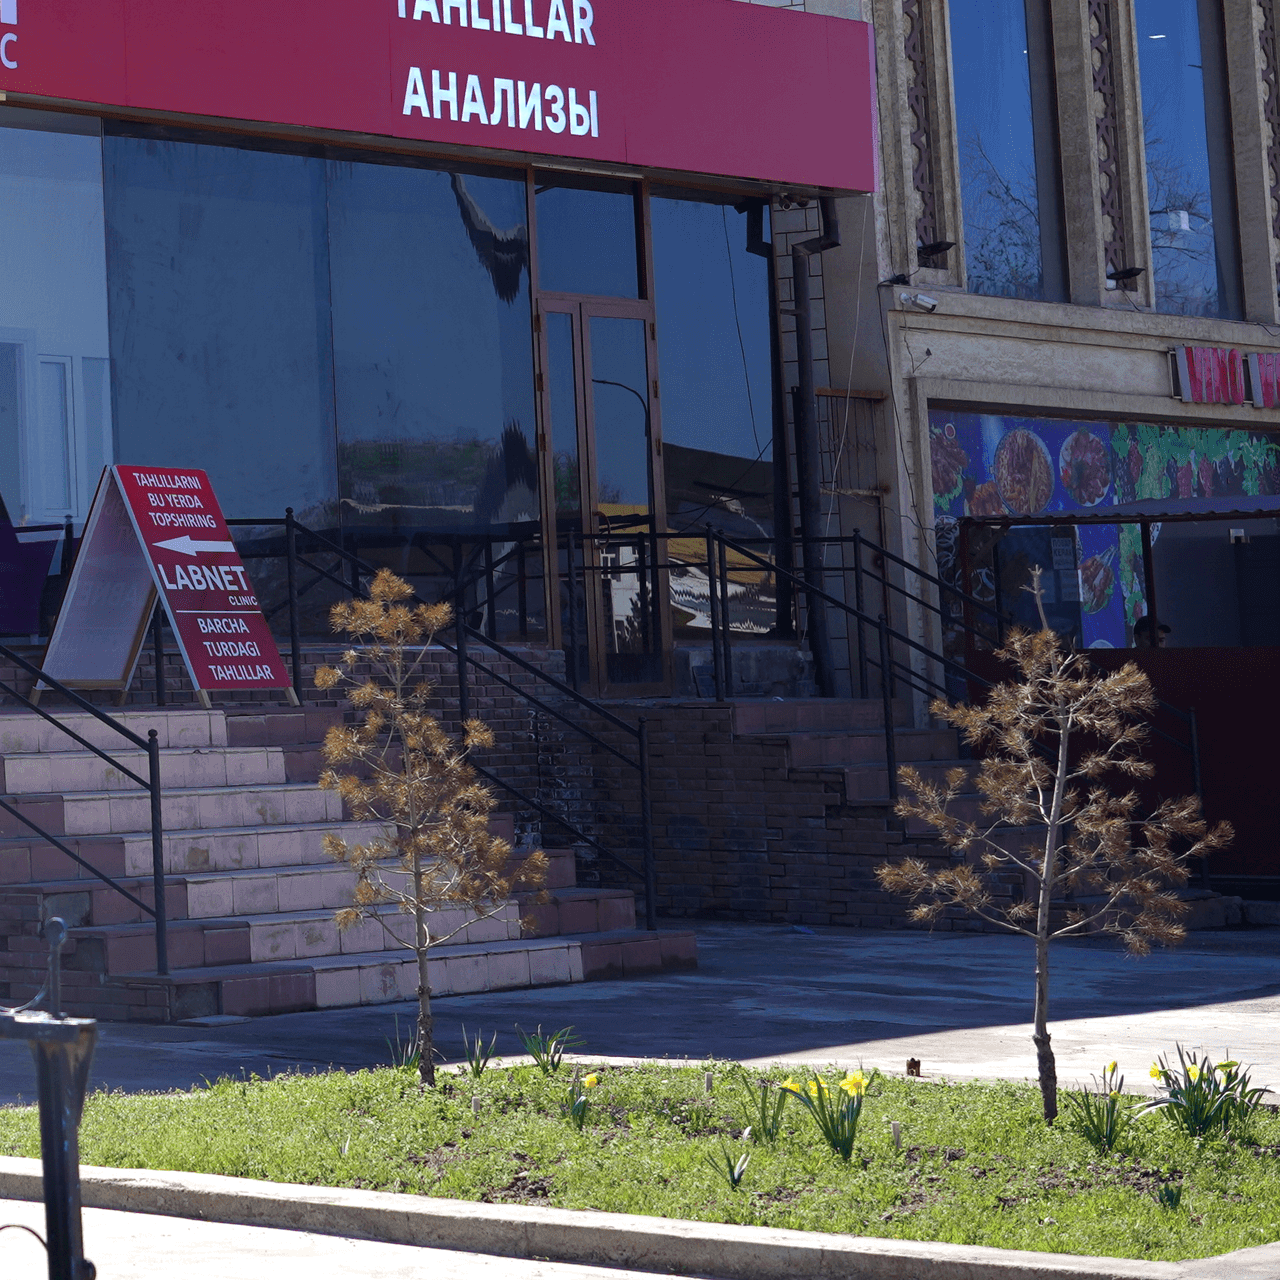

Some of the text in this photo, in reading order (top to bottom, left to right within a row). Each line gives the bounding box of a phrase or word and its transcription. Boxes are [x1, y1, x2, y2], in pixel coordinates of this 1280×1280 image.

[402, 66, 599, 138] АНАЛИЗЫ
[133, 472, 202, 490] TAHLILLARNI
[147, 493, 204, 509] BU YERDA
[148, 512, 217, 529] TOPSHIRING
[157, 564, 249, 591] LABNET
[228, 595, 258, 606] CLINIC
[197, 618, 250, 634] BARCHA
[203, 641, 261, 657] TURDAGI
[208, 665, 275, 681] TAHLILLAR
